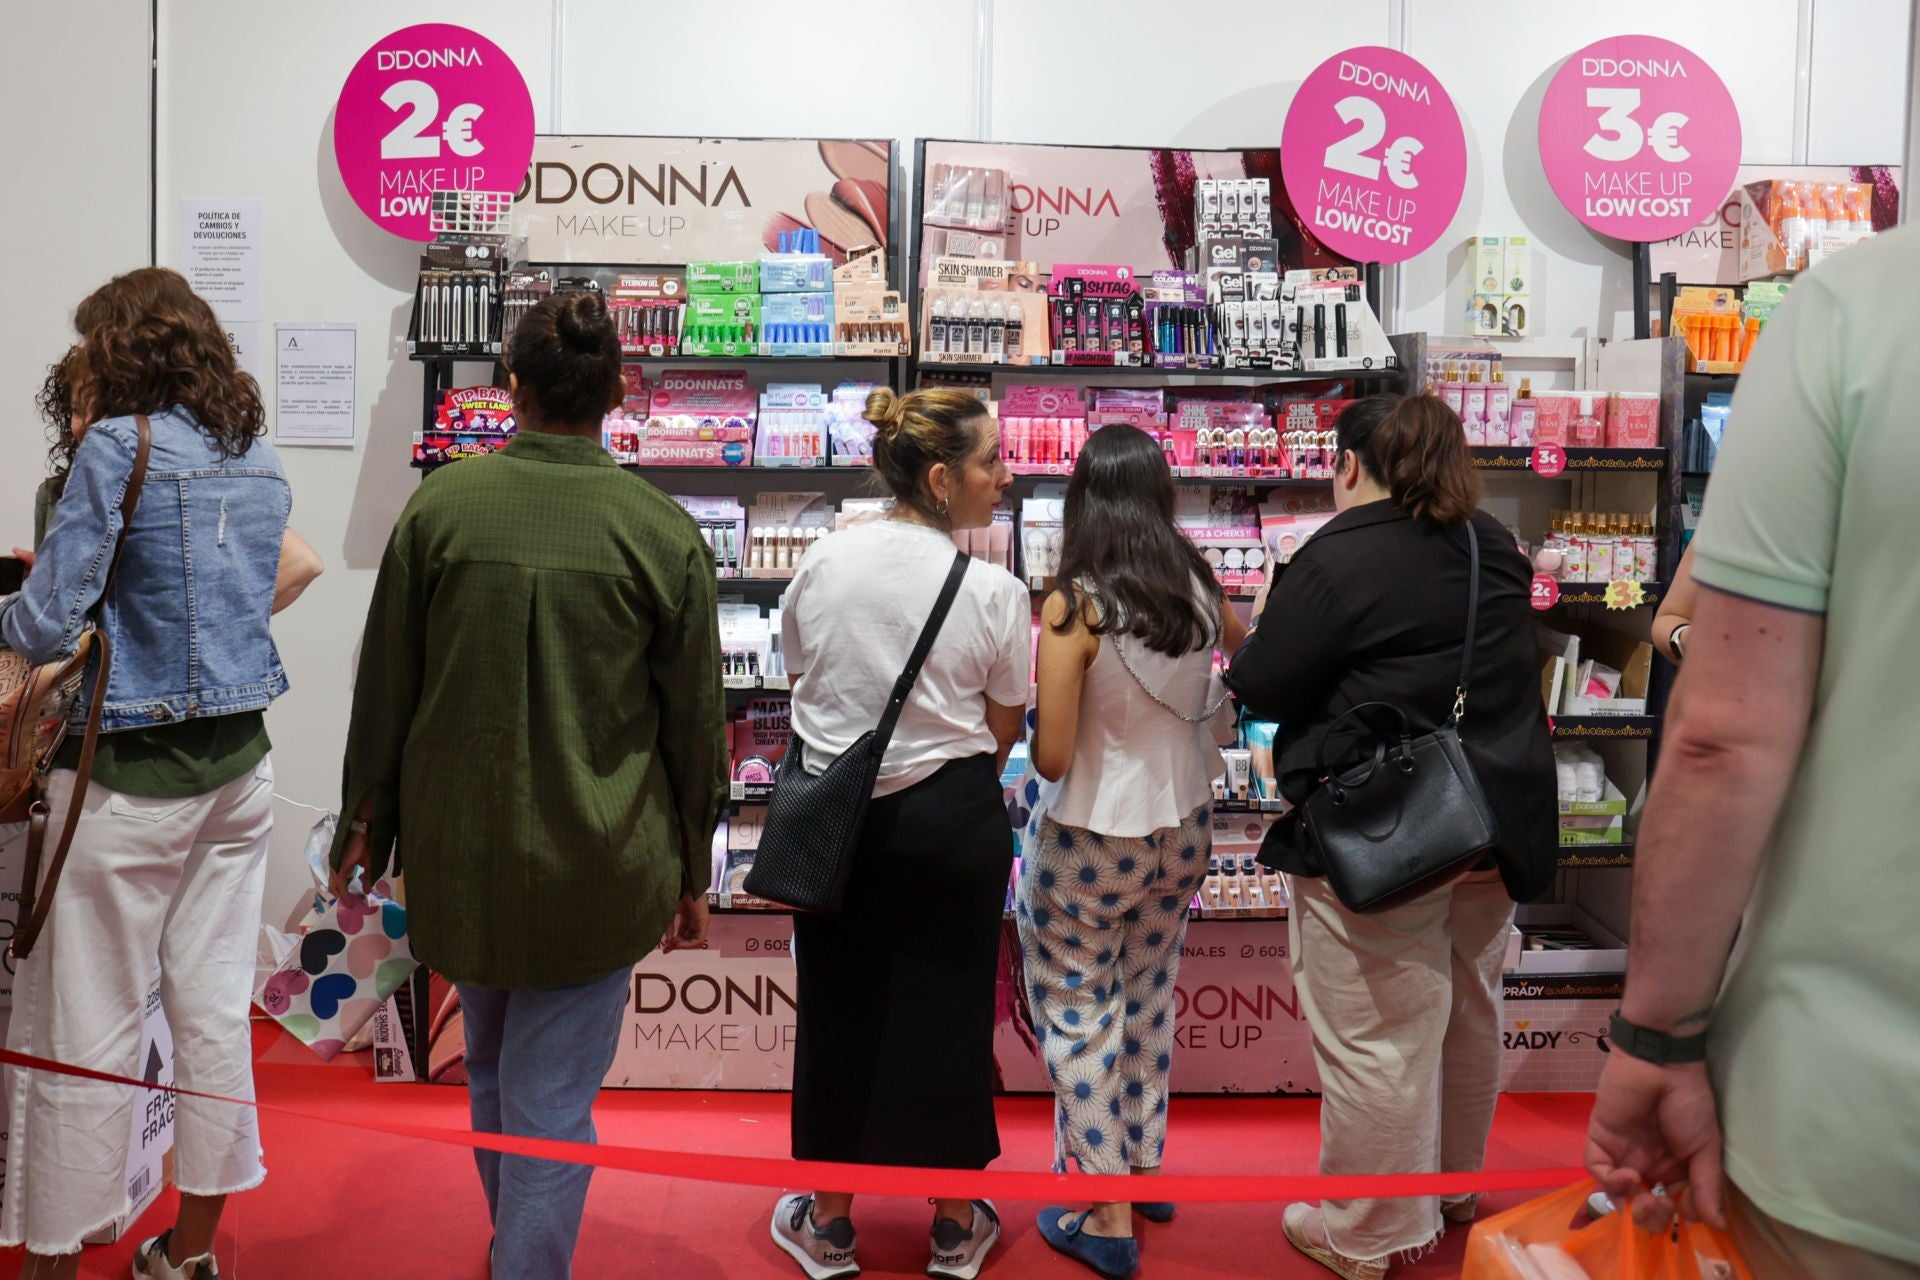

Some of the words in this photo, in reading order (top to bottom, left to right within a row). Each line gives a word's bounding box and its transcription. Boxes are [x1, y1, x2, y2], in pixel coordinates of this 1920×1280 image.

[380, 80, 484, 160] 2€
[1582, 87, 1692, 162] 3€
[1324, 96, 1424, 190] 2€
[380, 168, 445, 195] MAKE
[454, 166, 485, 192] UP
[1584, 172, 1651, 196] MAKE
[1660, 172, 1692, 196] UP
[1318, 178, 1382, 216] MAKE
[1386, 195, 1416, 223] UP
[198, 211, 230, 220] POLÍTICA
[232, 212, 241, 220] DE
[200, 222, 232, 230] CAMBIOS
[234, 222, 239, 230] Y
[556, 215, 636, 237] MAKE
[648, 216, 686, 238] UP
[1026, 218, 1060, 237] UP
[194, 232, 246, 240] DEVOLUCIONES
[1212, 245, 1236, 258] Gel
[938, 263, 960, 276] SKIN
[960, 264, 1003, 278] SHIMMER
[1221, 275, 1242, 287] Gel
[938, 353, 954, 362] SKIN
[954, 354, 982, 362] SHIMMER
[1074, 354, 1112, 362] HASHTAG
[664, 380, 744, 390] DDONNATS
[460, 401, 488, 410] SWEET
[488, 402, 511, 411] LAND
[1183, 405, 1208, 416] SHINE
[1288, 404, 1316, 416] SHINE
[1180, 416, 1210, 430] EFFECT
[1286, 416, 1318, 430] EFFECT
[642, 448, 714, 459] DDONNATS
[1190, 530, 1205, 538] LIPS
[1206, 530, 1212, 538] &
[1214, 530, 1244, 538] CHEEKS
[754, 716, 791, 730] BLUS
[1236, 760, 1248, 772] BB
[764, 938, 790, 952] 605
[1258, 946, 1286, 958] 605
[1503, 986, 1544, 996] PRADY
[636, 1023, 740, 1051] MAKE
[1219, 1026, 1262, 1049] UP
